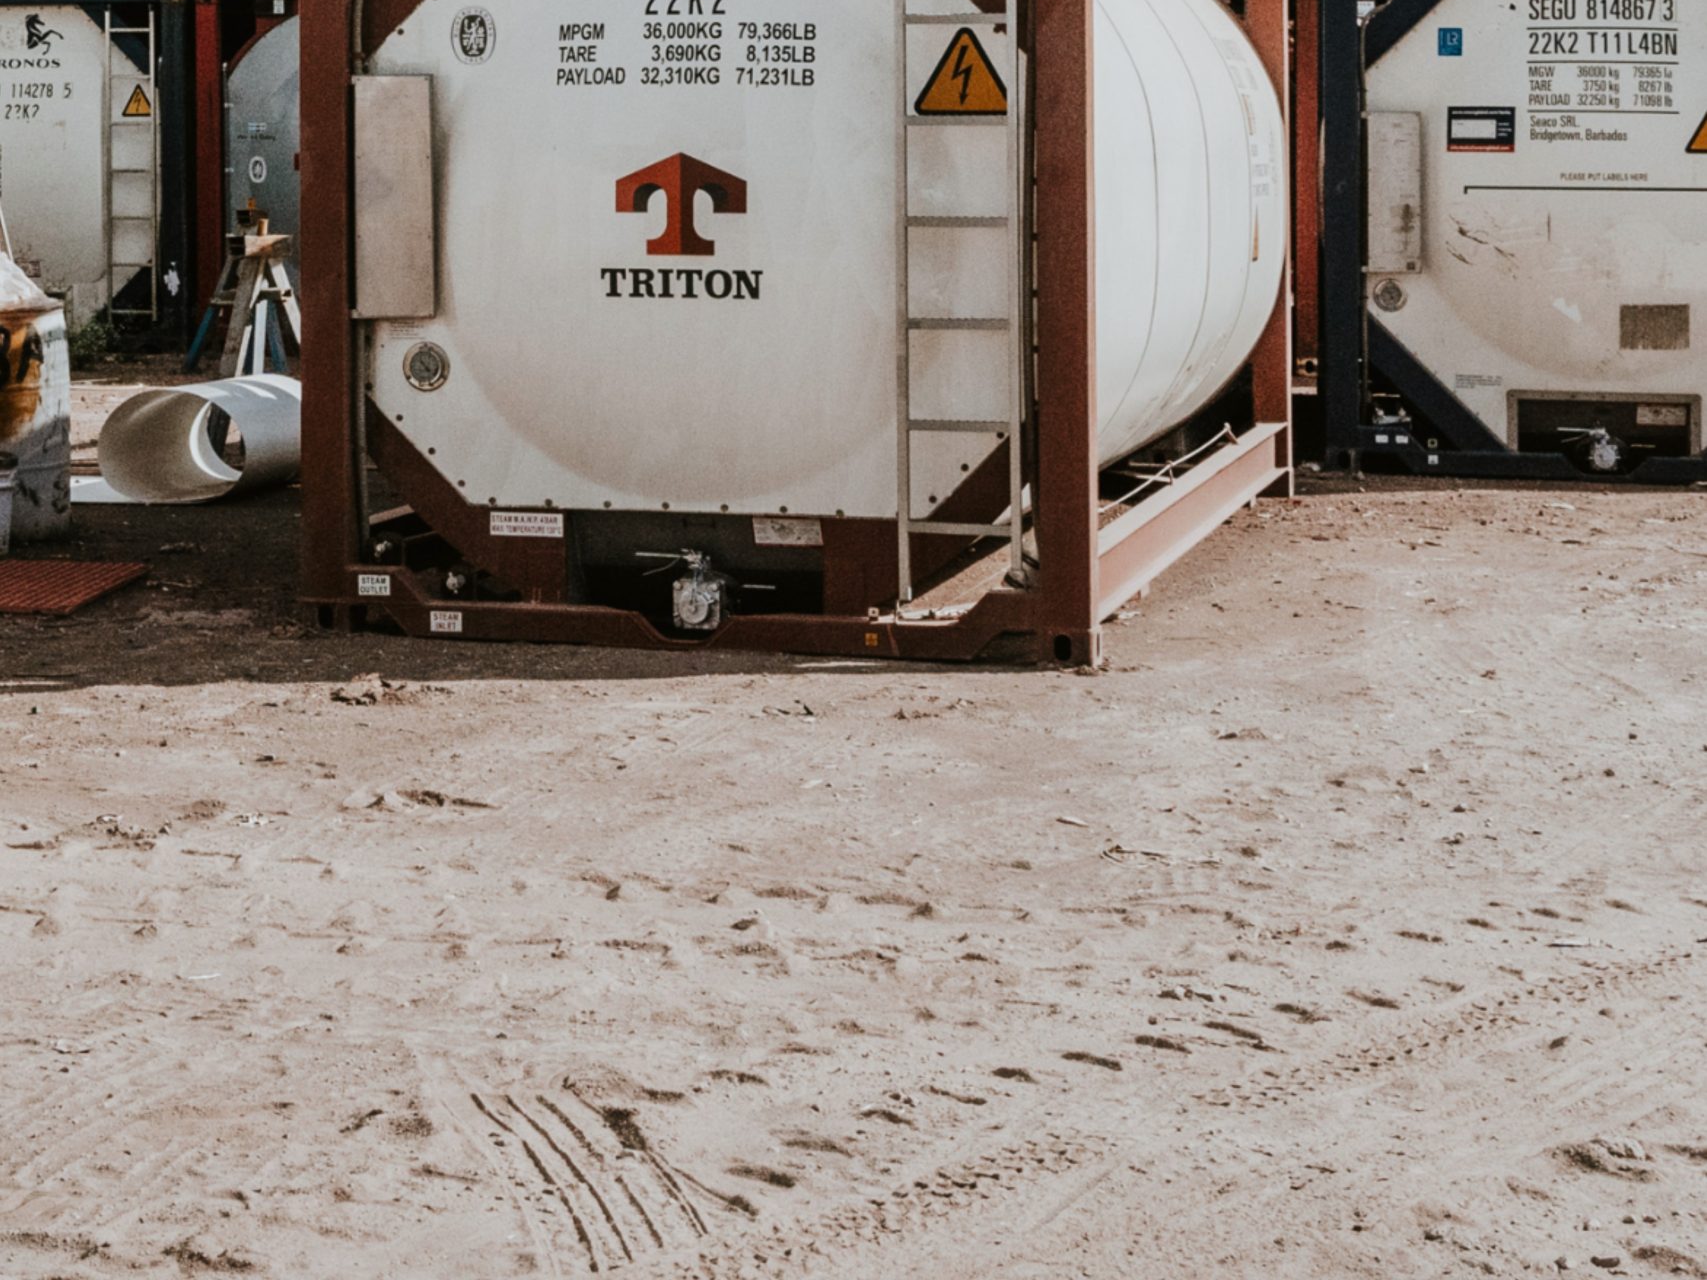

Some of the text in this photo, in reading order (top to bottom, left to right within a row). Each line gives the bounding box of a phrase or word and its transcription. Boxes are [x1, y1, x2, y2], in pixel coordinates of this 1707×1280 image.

[559, 22, 817, 41] MPGM 36,000KG 79,366LB
[1528, 32, 1678, 55] 22K2 T11 L4BN
[559, 45, 816, 65] TARE 3,690KG 8,135LB
[556, 67, 815, 87] PAYLOAD 32,310KG 71,231LB
[1528, 66, 1556, 77] MGW
[1577, 66, 1606, 78] 36000
[1608, 66, 1620, 80] kg
[12, 83, 72, 99] 114278 5
[1529, 80, 1552, 92] TARE
[1582, 80, 1606, 92] 3750
[1608, 80, 1620, 94] kg
[1638, 81, 1662, 92] 8267
[1528, 94, 1570, 106] PAYLOAD
[1577, 94, 1606, 106] 32250
[1608, 95, 1620, 108] kg
[1530, 115, 1557, 127] Seaco
[1530, 128, 1628, 143] Bridgetown, Barbados
[601, 268, 764, 299] TRITON
[361, 577, 386, 585] STEAM
[433, 613, 459, 621] STEAM
